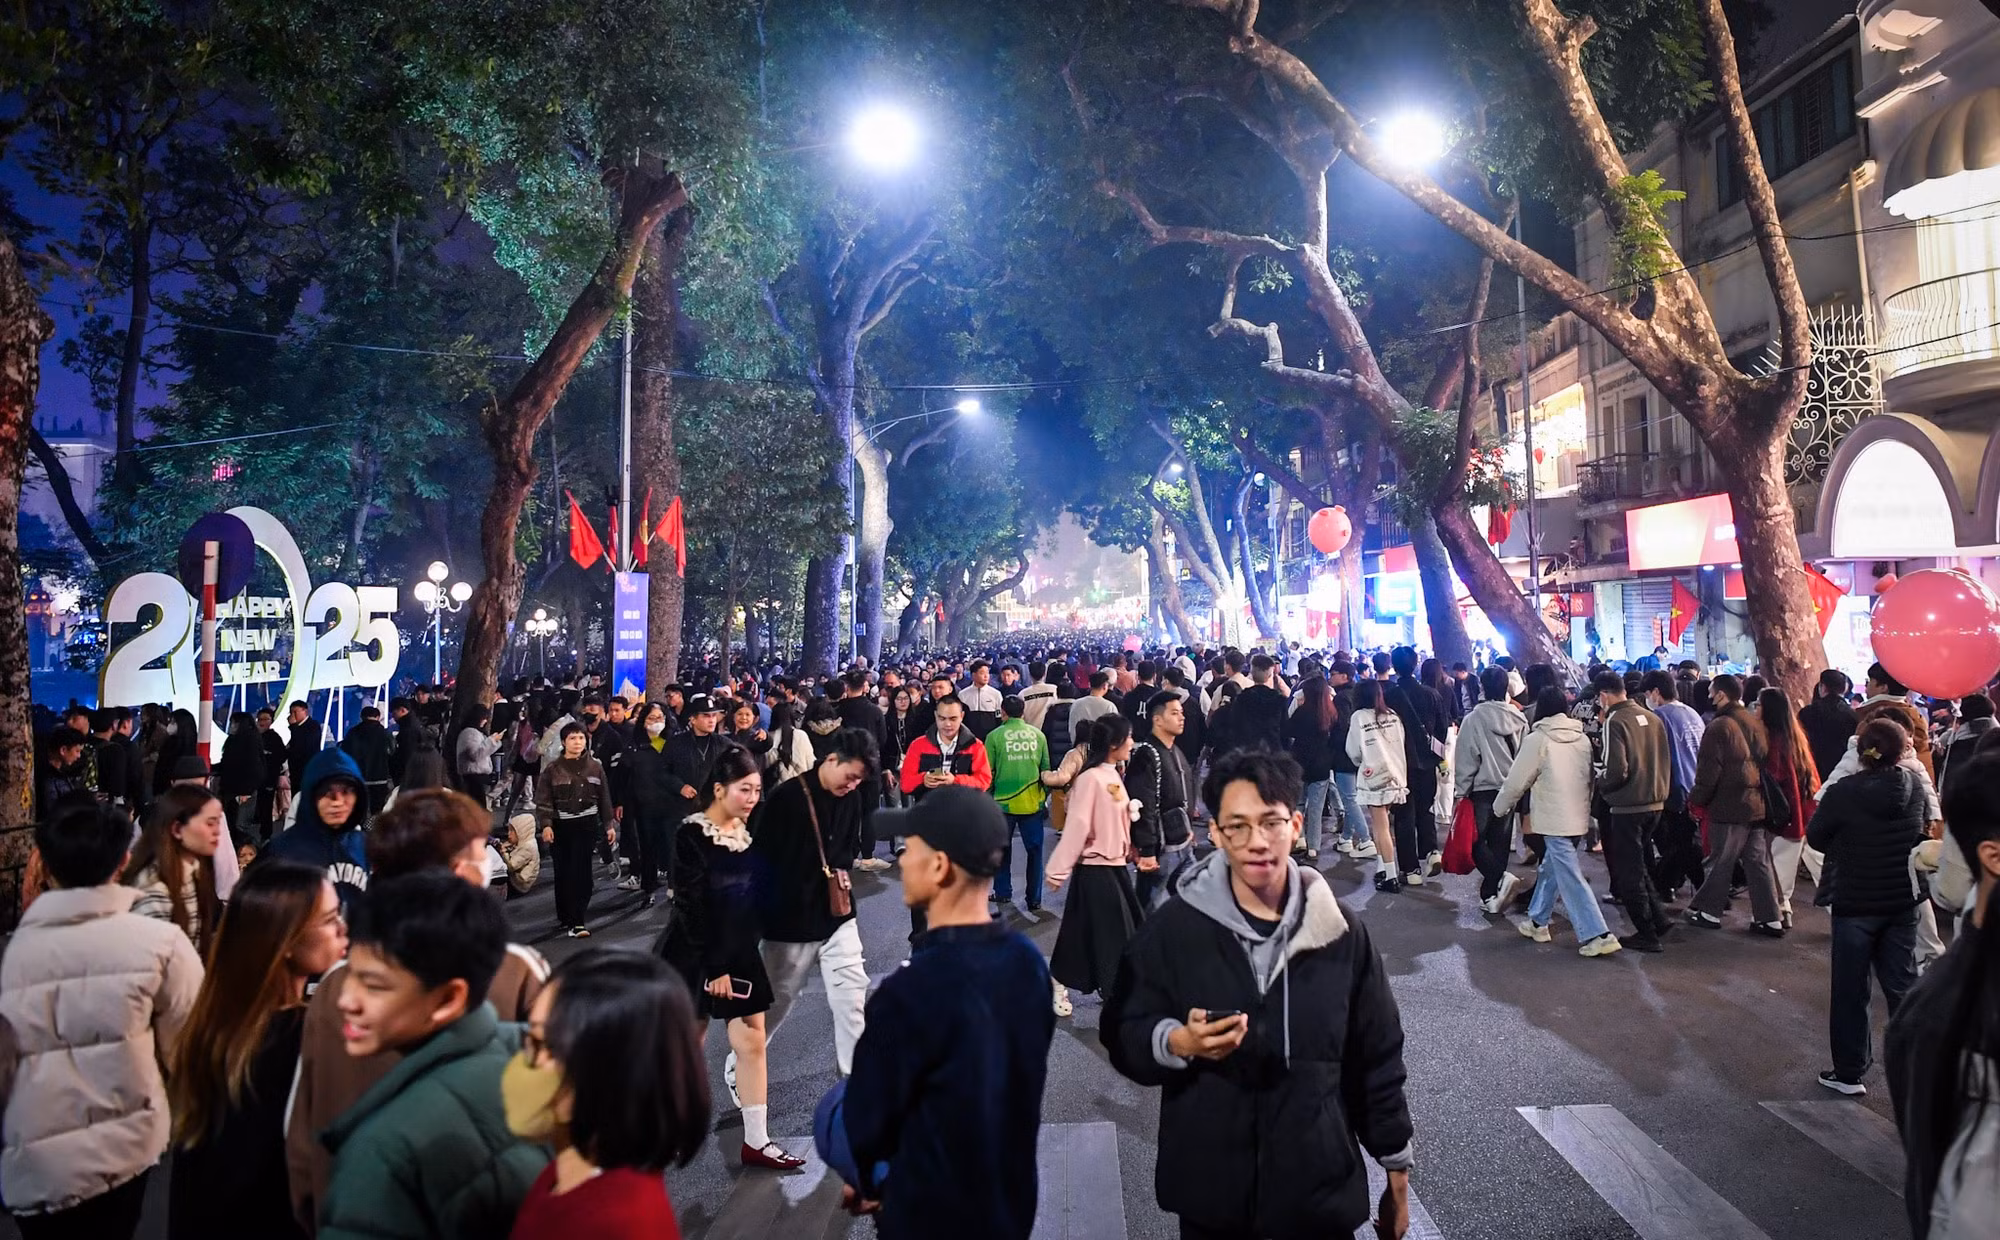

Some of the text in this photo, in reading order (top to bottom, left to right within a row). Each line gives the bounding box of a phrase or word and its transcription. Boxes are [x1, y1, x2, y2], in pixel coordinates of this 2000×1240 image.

[216, 596, 291, 618] HAPPY
[220, 629, 277, 652] NEW
[217, 661, 280, 684] YEAR
[1004, 727, 1037, 741] Grab
[1005, 739, 1038, 752] Food
